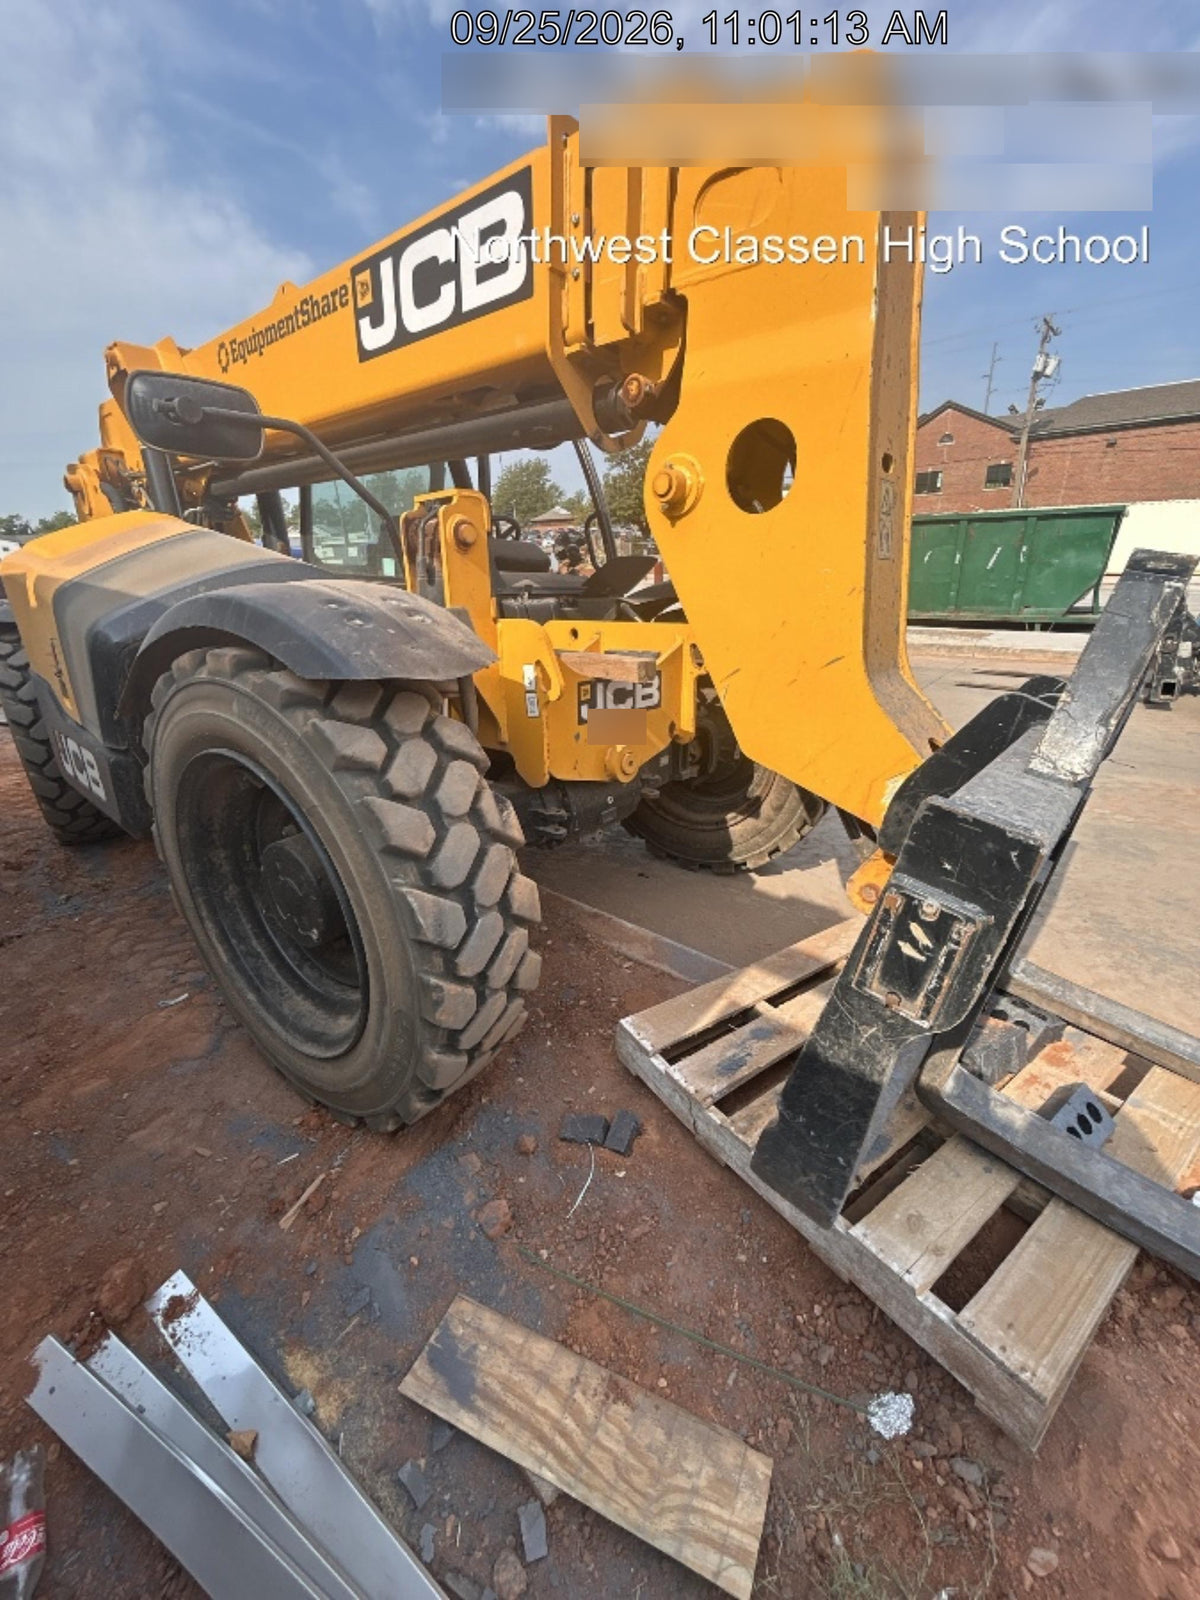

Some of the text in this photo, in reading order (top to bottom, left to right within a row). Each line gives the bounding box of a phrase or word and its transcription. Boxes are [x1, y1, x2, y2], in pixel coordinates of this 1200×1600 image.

[358, 190, 528, 351] JCB
[229, 283, 349, 365] EquipmentShare
[58, 732, 107, 801] JCB
